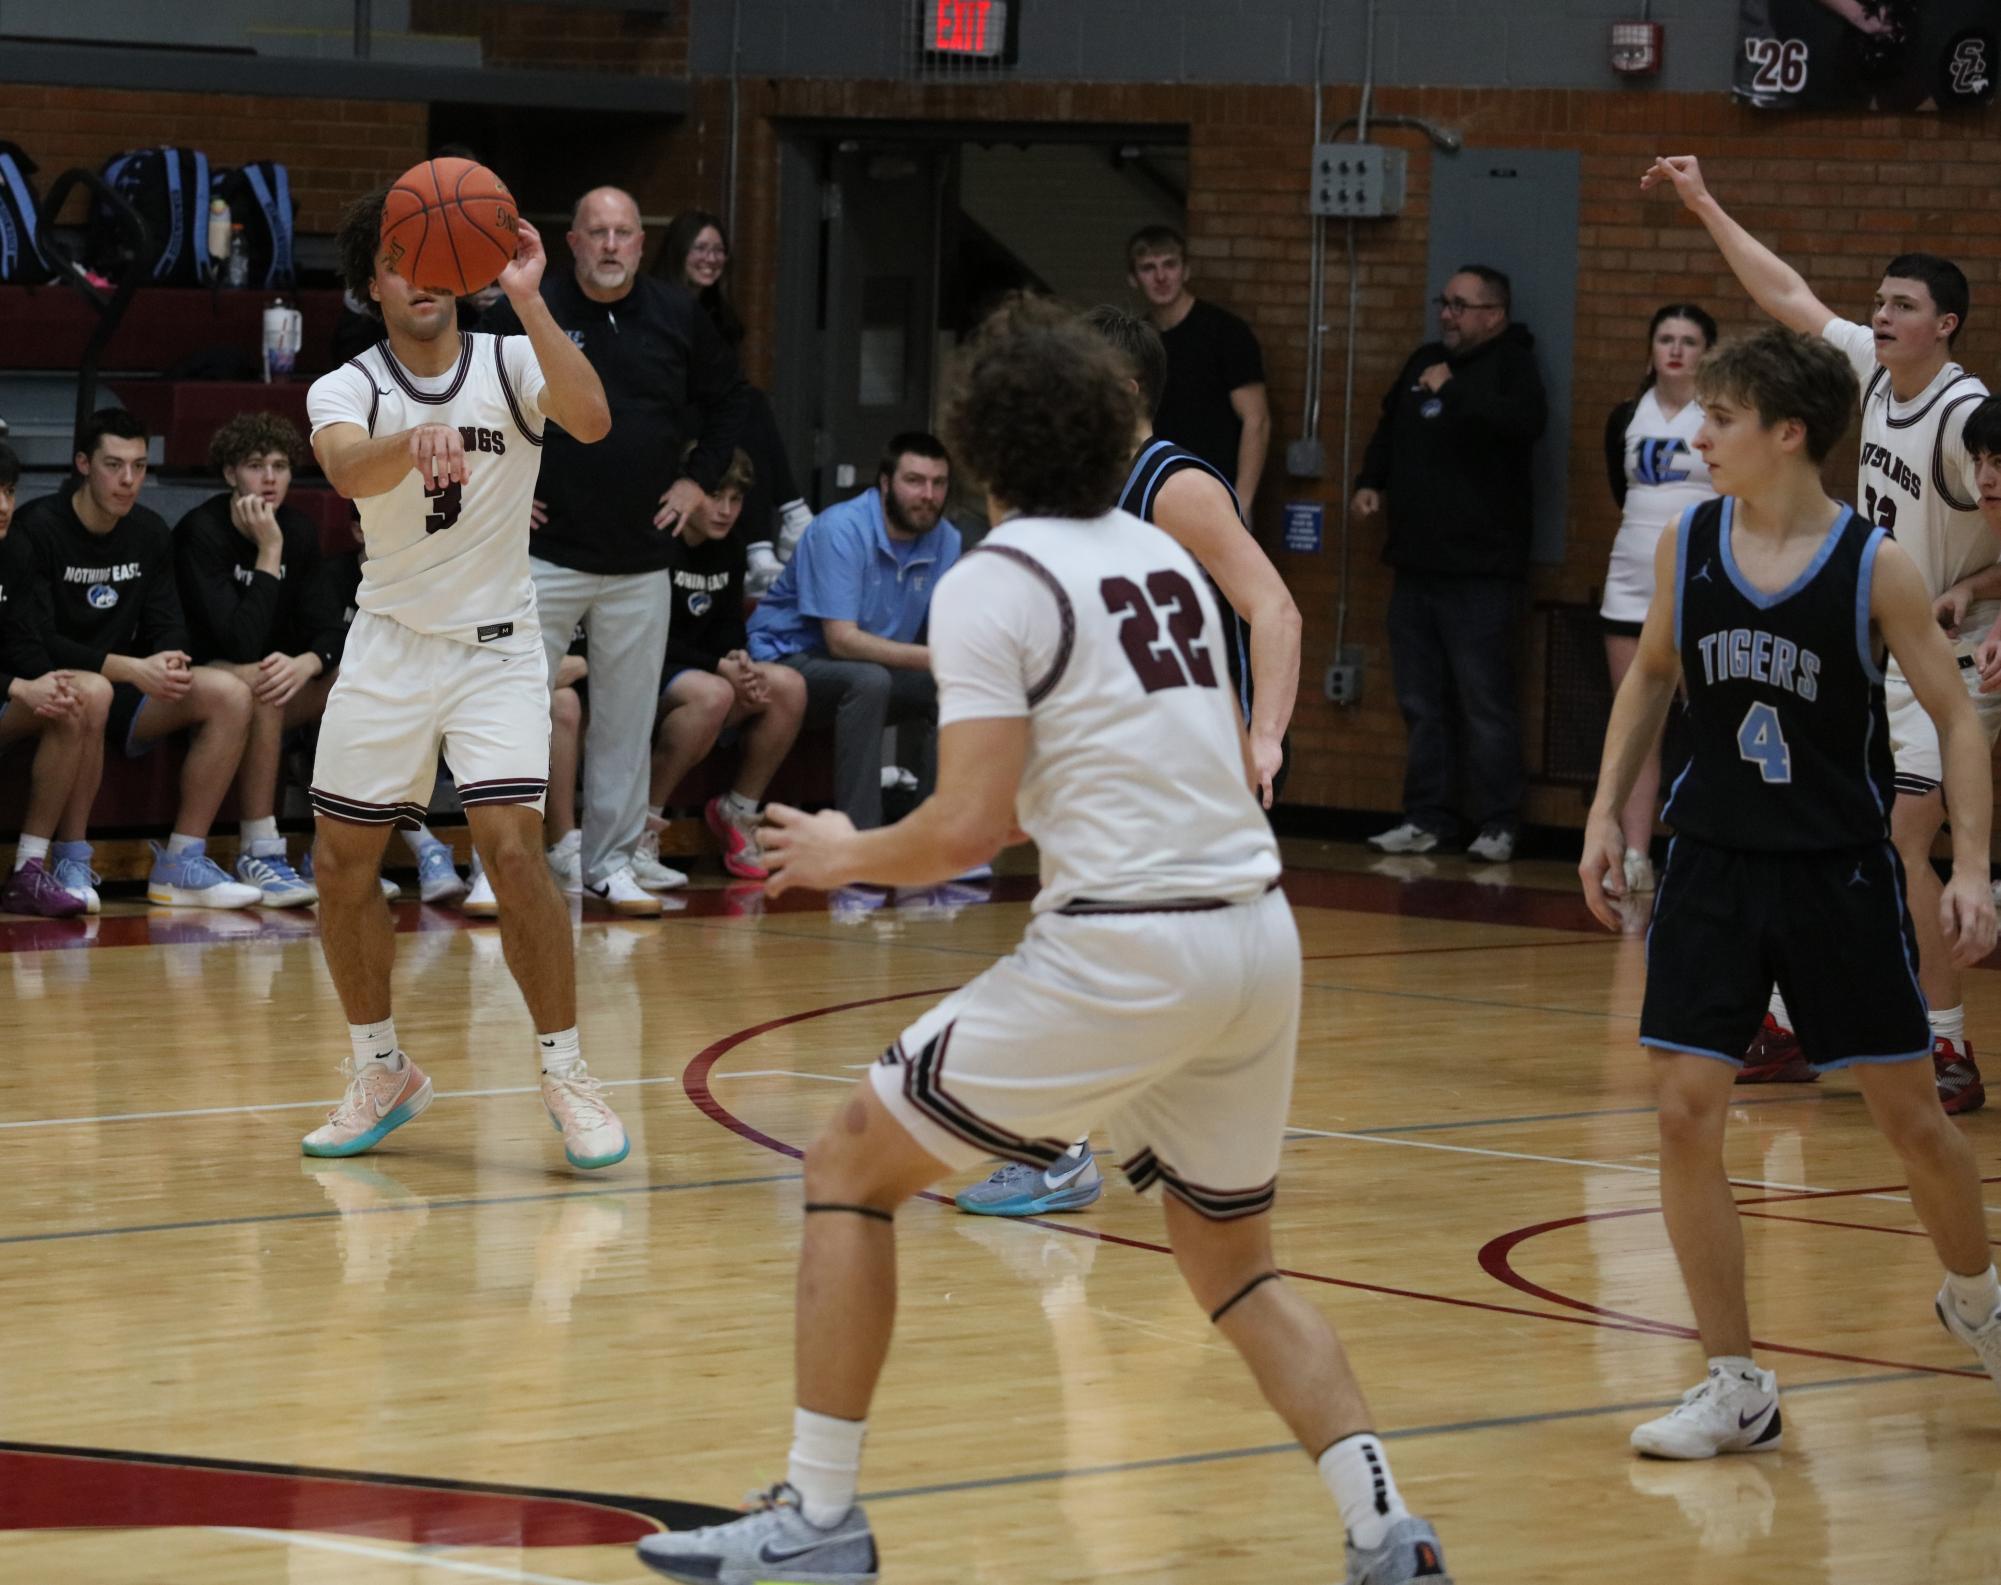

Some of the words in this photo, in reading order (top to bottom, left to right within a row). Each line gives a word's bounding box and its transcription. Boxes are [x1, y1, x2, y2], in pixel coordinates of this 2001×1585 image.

[936, 0, 992, 52] EXIT
[1745, 37, 1808, 93] '26
[424, 475, 463, 535] 3
[1099, 568, 1219, 695] 22
[1698, 628, 1821, 702] TIGERS
[1736, 700, 1792, 783] 4
